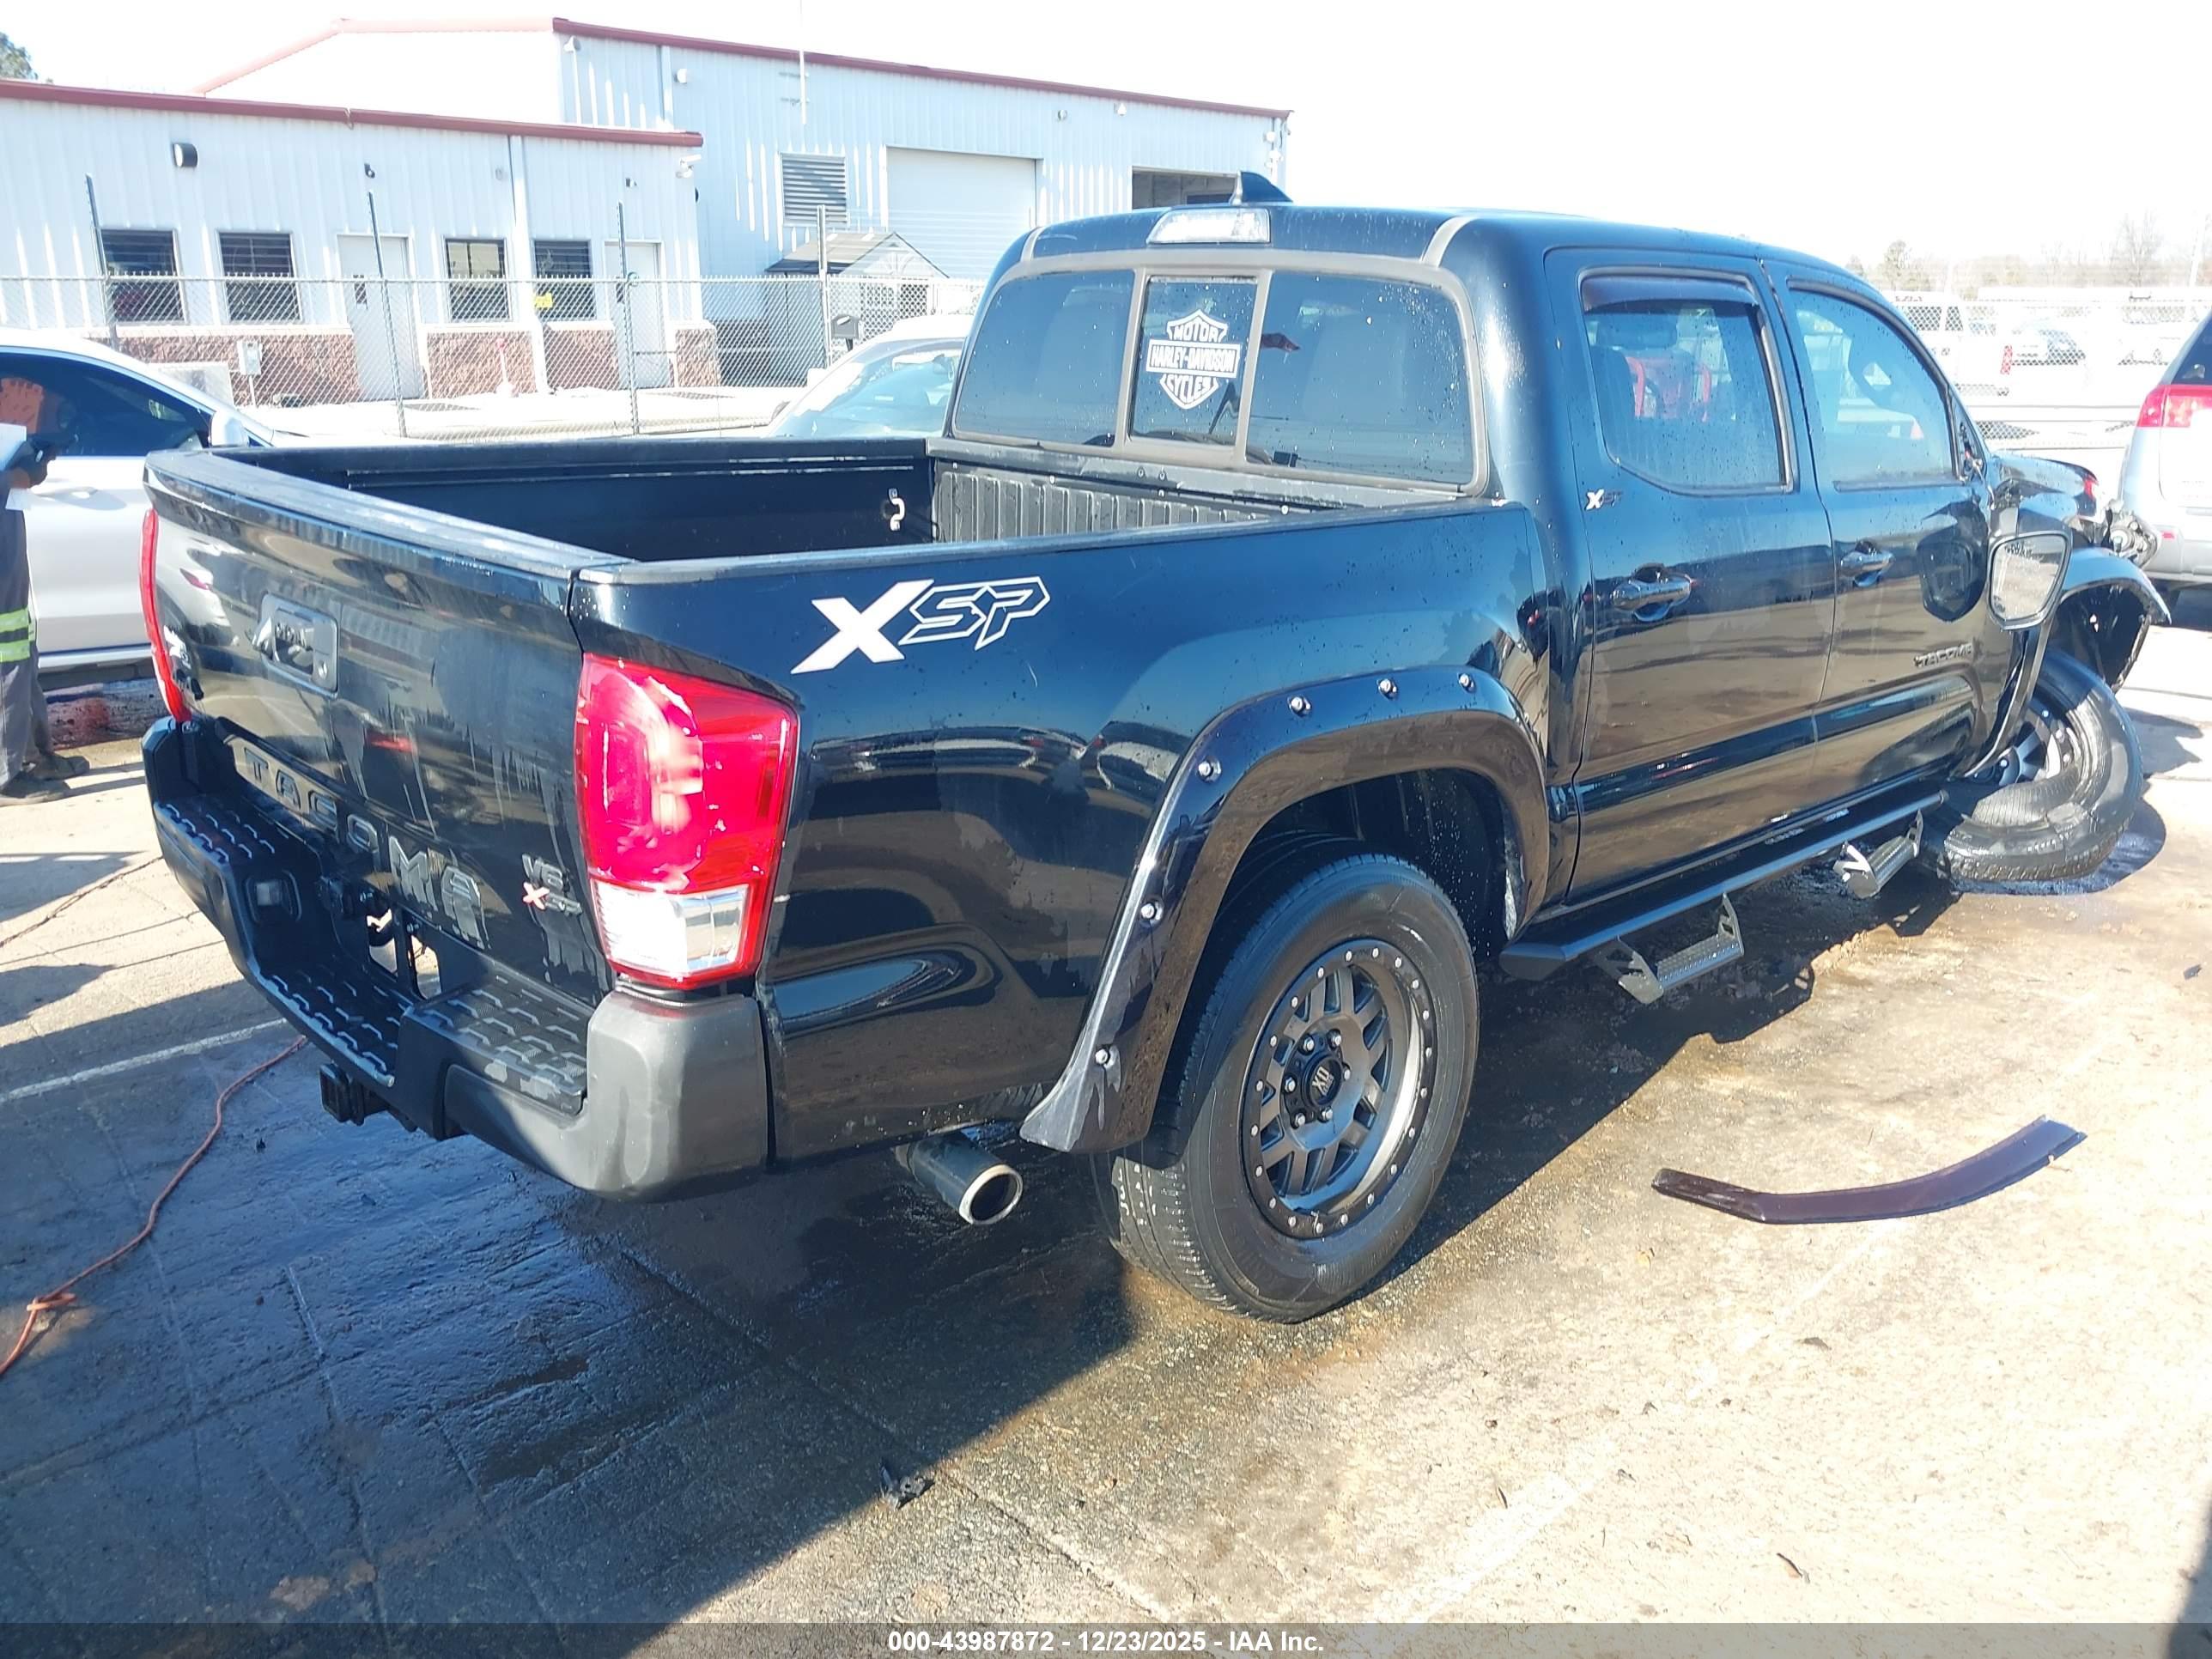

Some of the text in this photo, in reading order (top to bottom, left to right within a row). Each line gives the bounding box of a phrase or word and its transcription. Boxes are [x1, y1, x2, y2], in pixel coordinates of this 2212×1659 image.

[1173, 315, 1219, 343] MOTOR
[1151, 344, 1237, 373] HARLEY-DAVIDSON
[1166, 374, 1212, 404] CYCLES
[243, 745, 493, 950] TACOMA
[521, 854, 564, 893] V6
